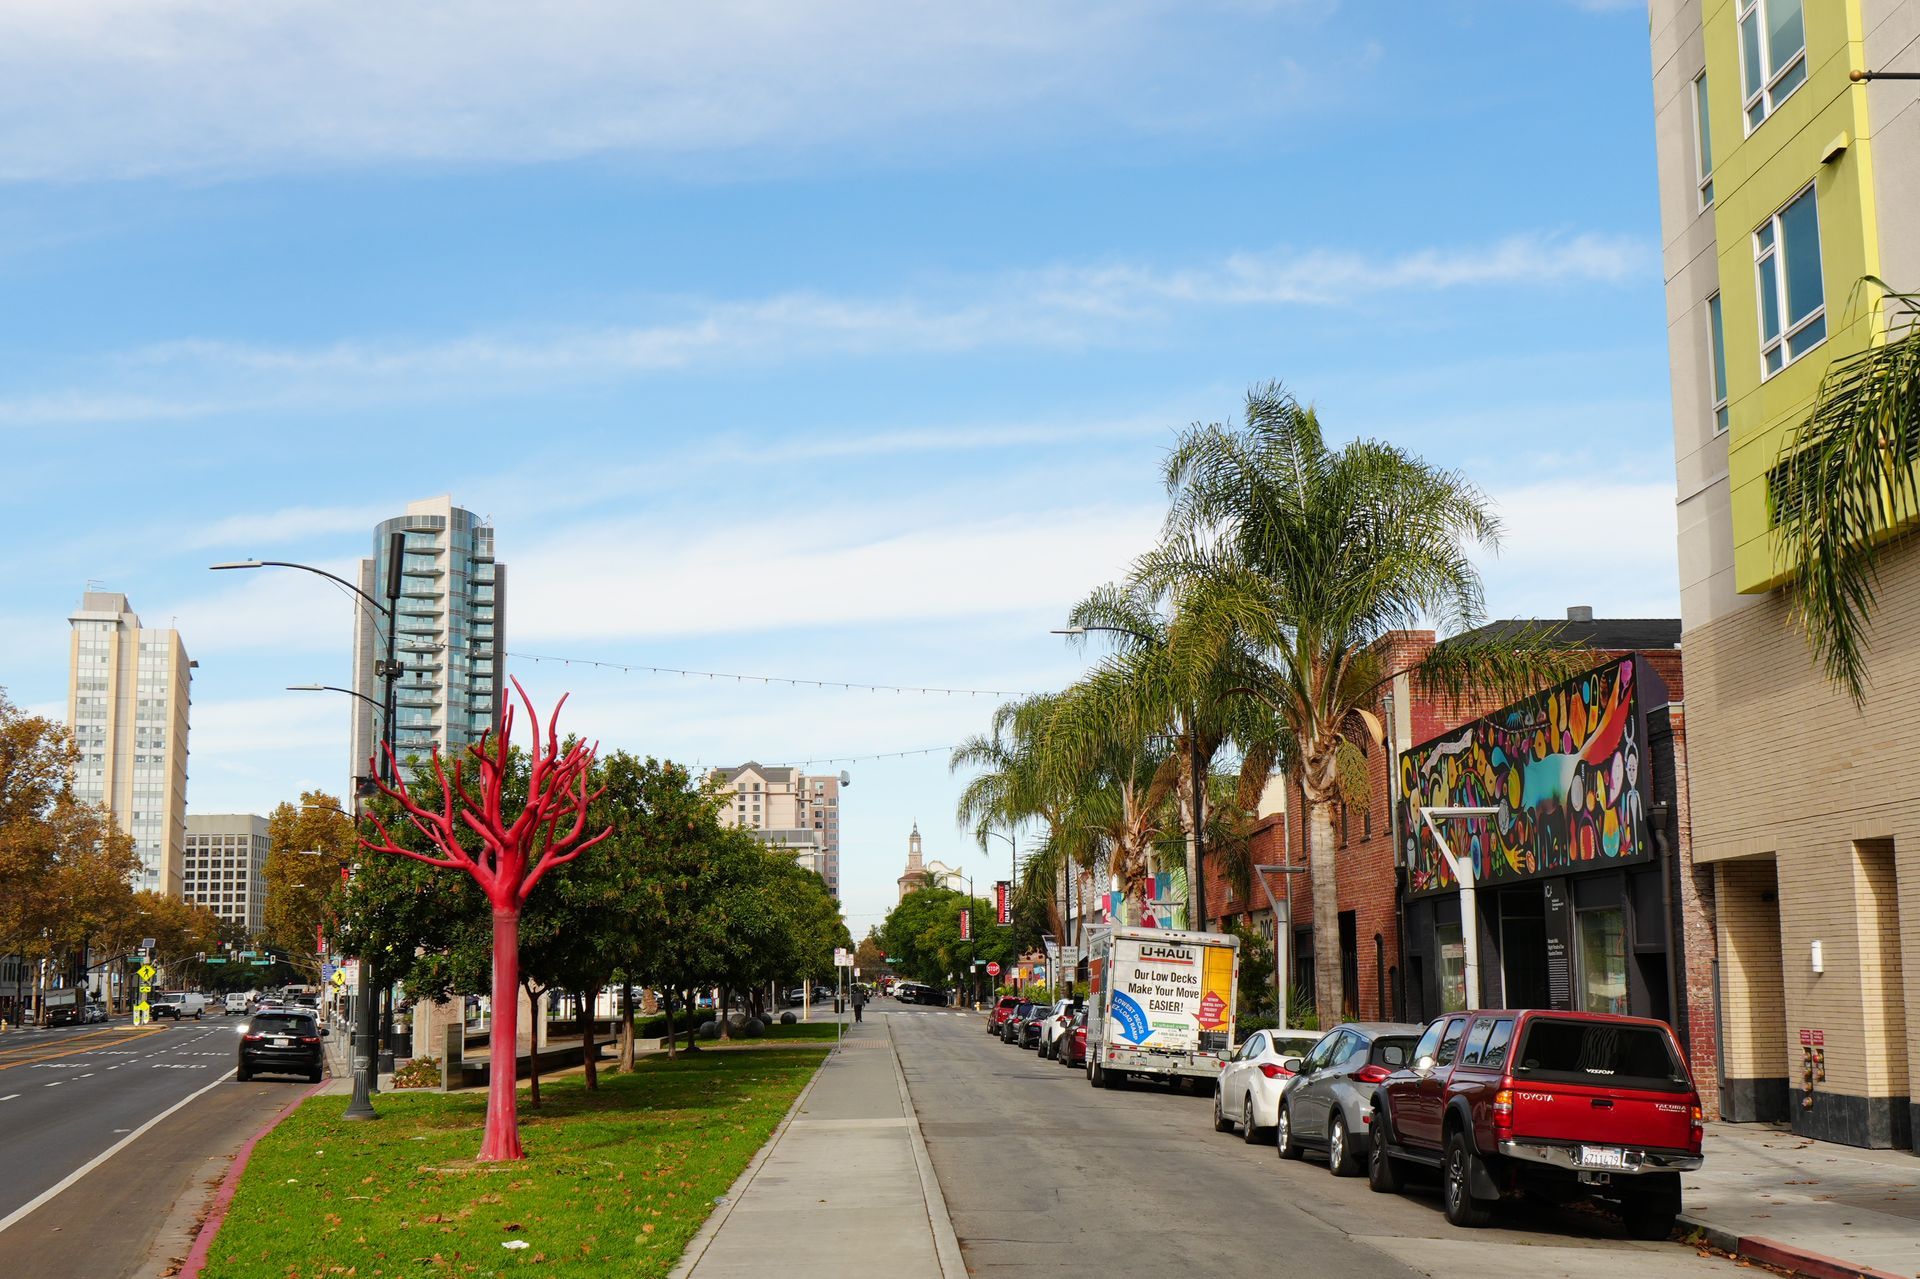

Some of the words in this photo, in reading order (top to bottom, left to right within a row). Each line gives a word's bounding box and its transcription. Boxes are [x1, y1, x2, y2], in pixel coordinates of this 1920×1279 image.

[1141, 946, 1193, 960] U-HAUL
[1134, 968, 1149, 980] Our
[1151, 970, 1169, 982] Low
[1170, 972, 1198, 985] Decks
[1128, 983, 1152, 995] Make
[1154, 985, 1175, 997] Your
[1176, 987, 1200, 999] Move
[1149, 999, 1184, 1013] EASIER!
[1112, 1004, 1132, 1023] EZ-LOAD
[1129, 1021, 1139, 1040] RAMP
[1114, 997, 1136, 1016] LOWEST
[1134, 1013, 1145, 1035] DECKS
[1517, 1091, 1555, 1102] TOYOTA
[1654, 1103, 1687, 1111] TACOMA
